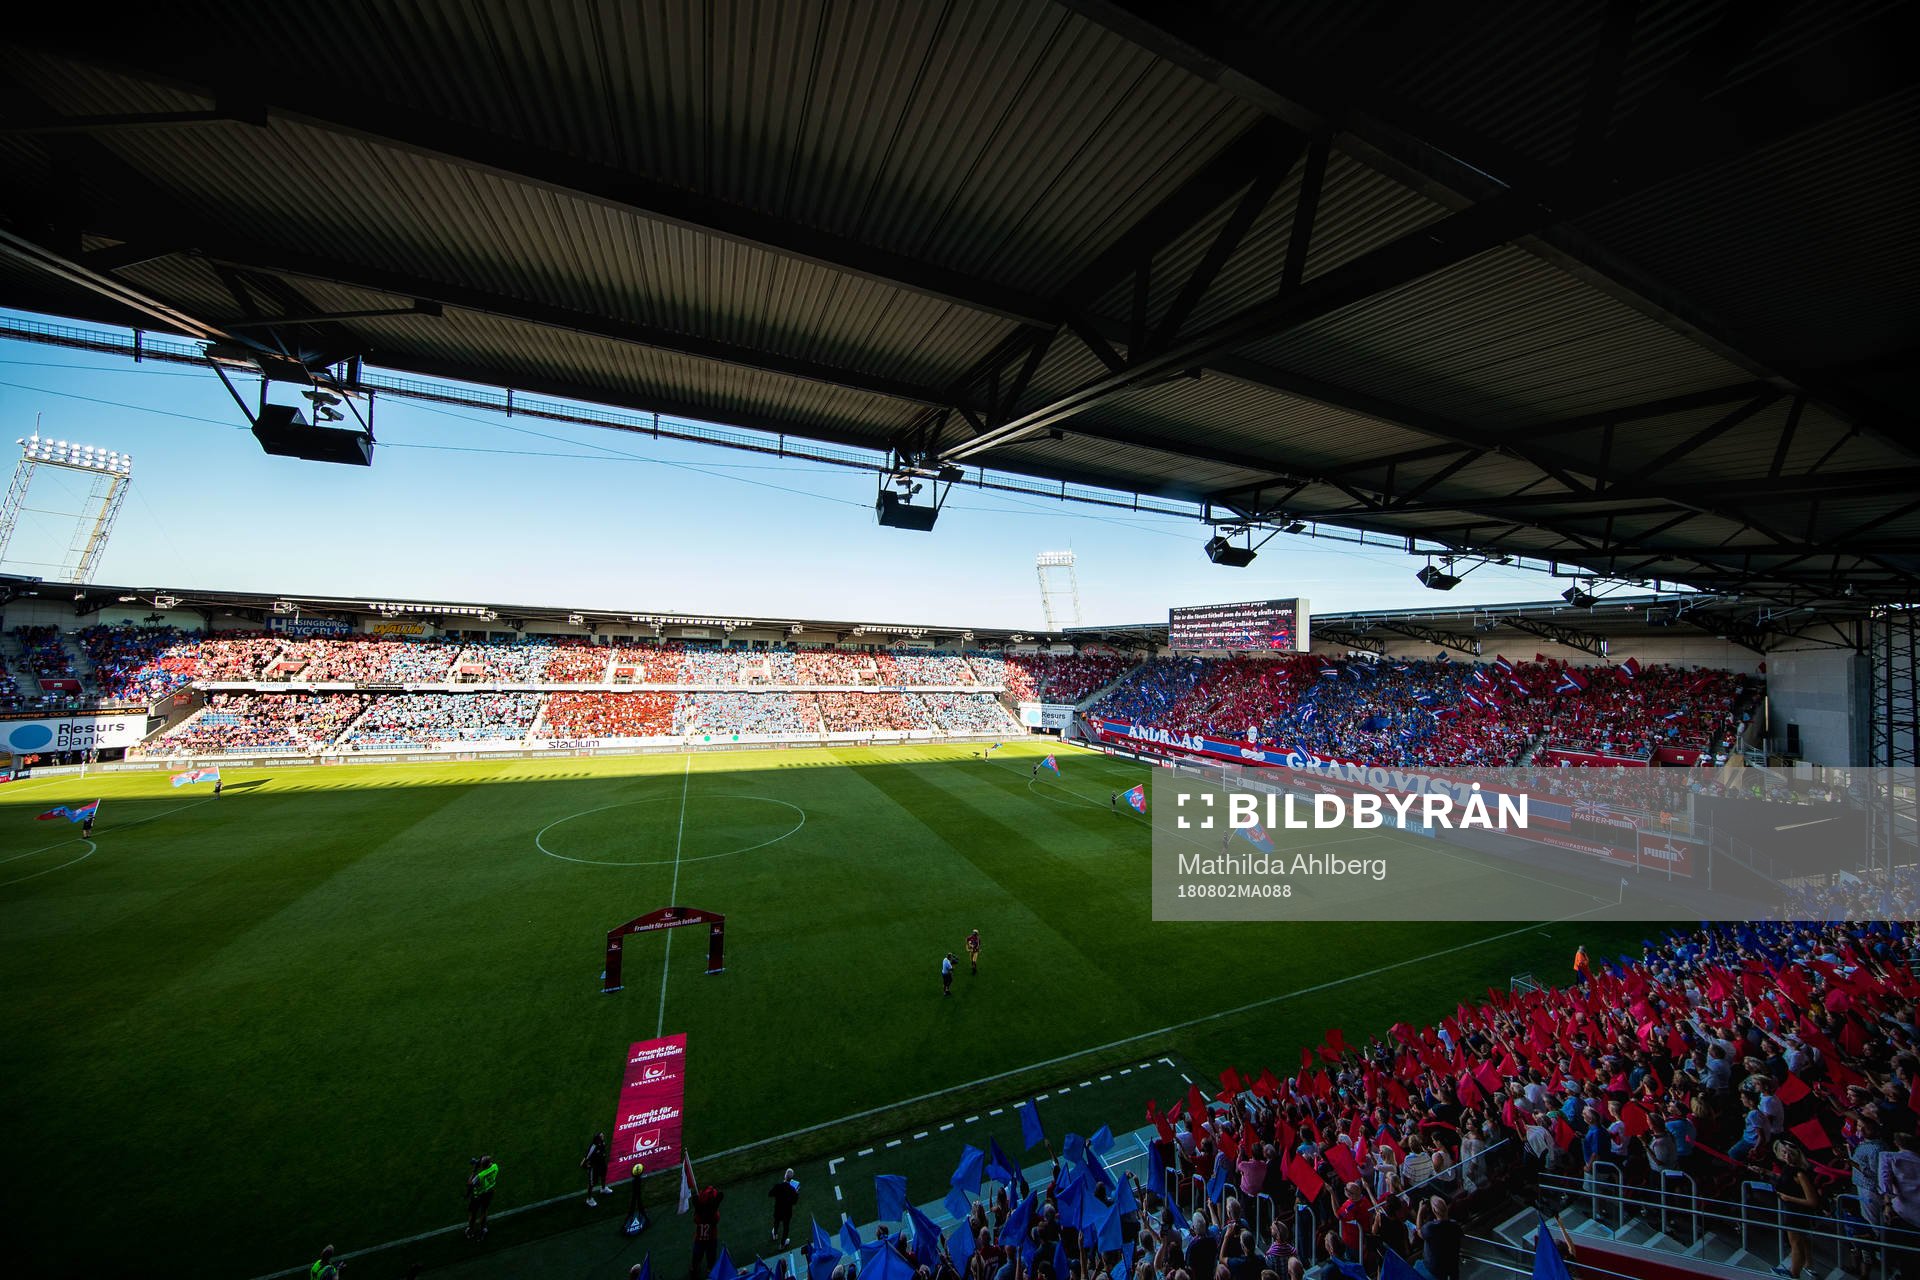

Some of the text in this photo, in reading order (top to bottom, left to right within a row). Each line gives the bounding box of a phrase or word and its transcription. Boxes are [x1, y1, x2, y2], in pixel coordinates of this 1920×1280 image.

[58, 722, 126, 735] Resurs
[57, 734, 105, 747] Bank
[548, 739, 600, 749] stadium
[1286, 752, 1473, 806] GRANQVIST
[630, 1053, 655, 1063] svensk
[638, 1046, 664, 1057] Framåt
[630, 1073, 676, 1087] SVENSKA SPEL
[628, 1106, 672, 1122] Framåt för
[619, 1119, 647, 1131] svensk
[619, 1145, 672, 1162] SVENSKA SPEL
